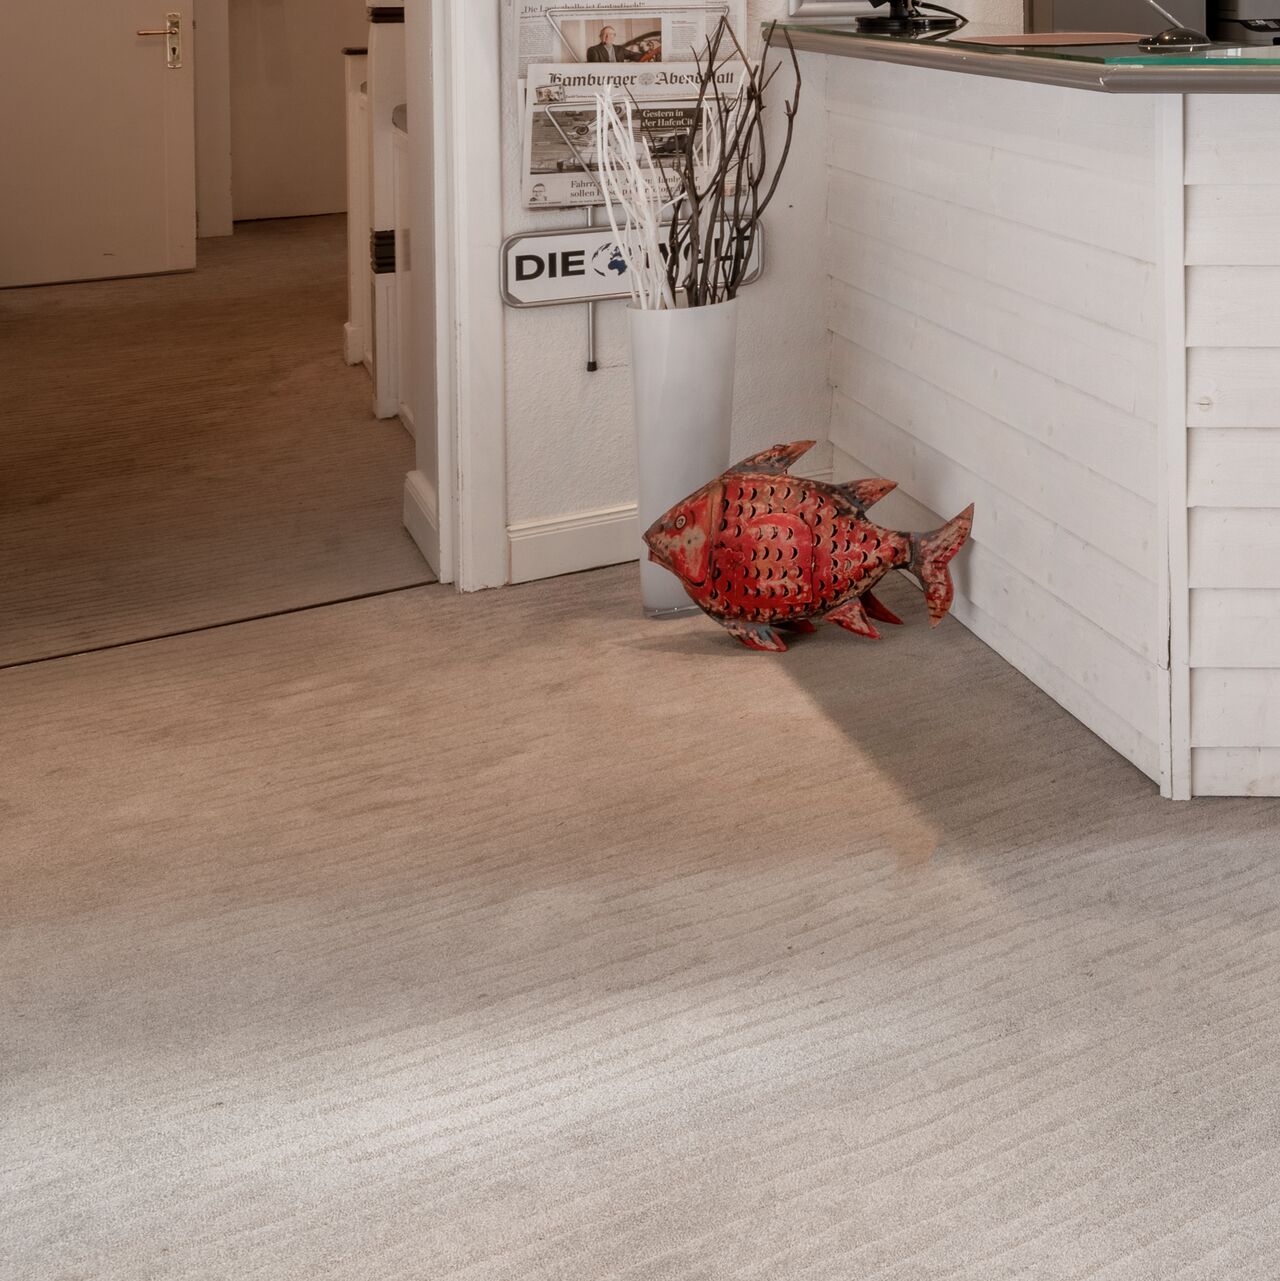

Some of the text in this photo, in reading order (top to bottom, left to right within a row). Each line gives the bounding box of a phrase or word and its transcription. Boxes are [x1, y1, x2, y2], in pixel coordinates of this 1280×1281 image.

[549, 72, 637, 88] Hamburger
[642, 109, 684, 118] Gestern in
[657, 118, 693, 127] HafenCit
[515, 250, 585, 281] DIE
